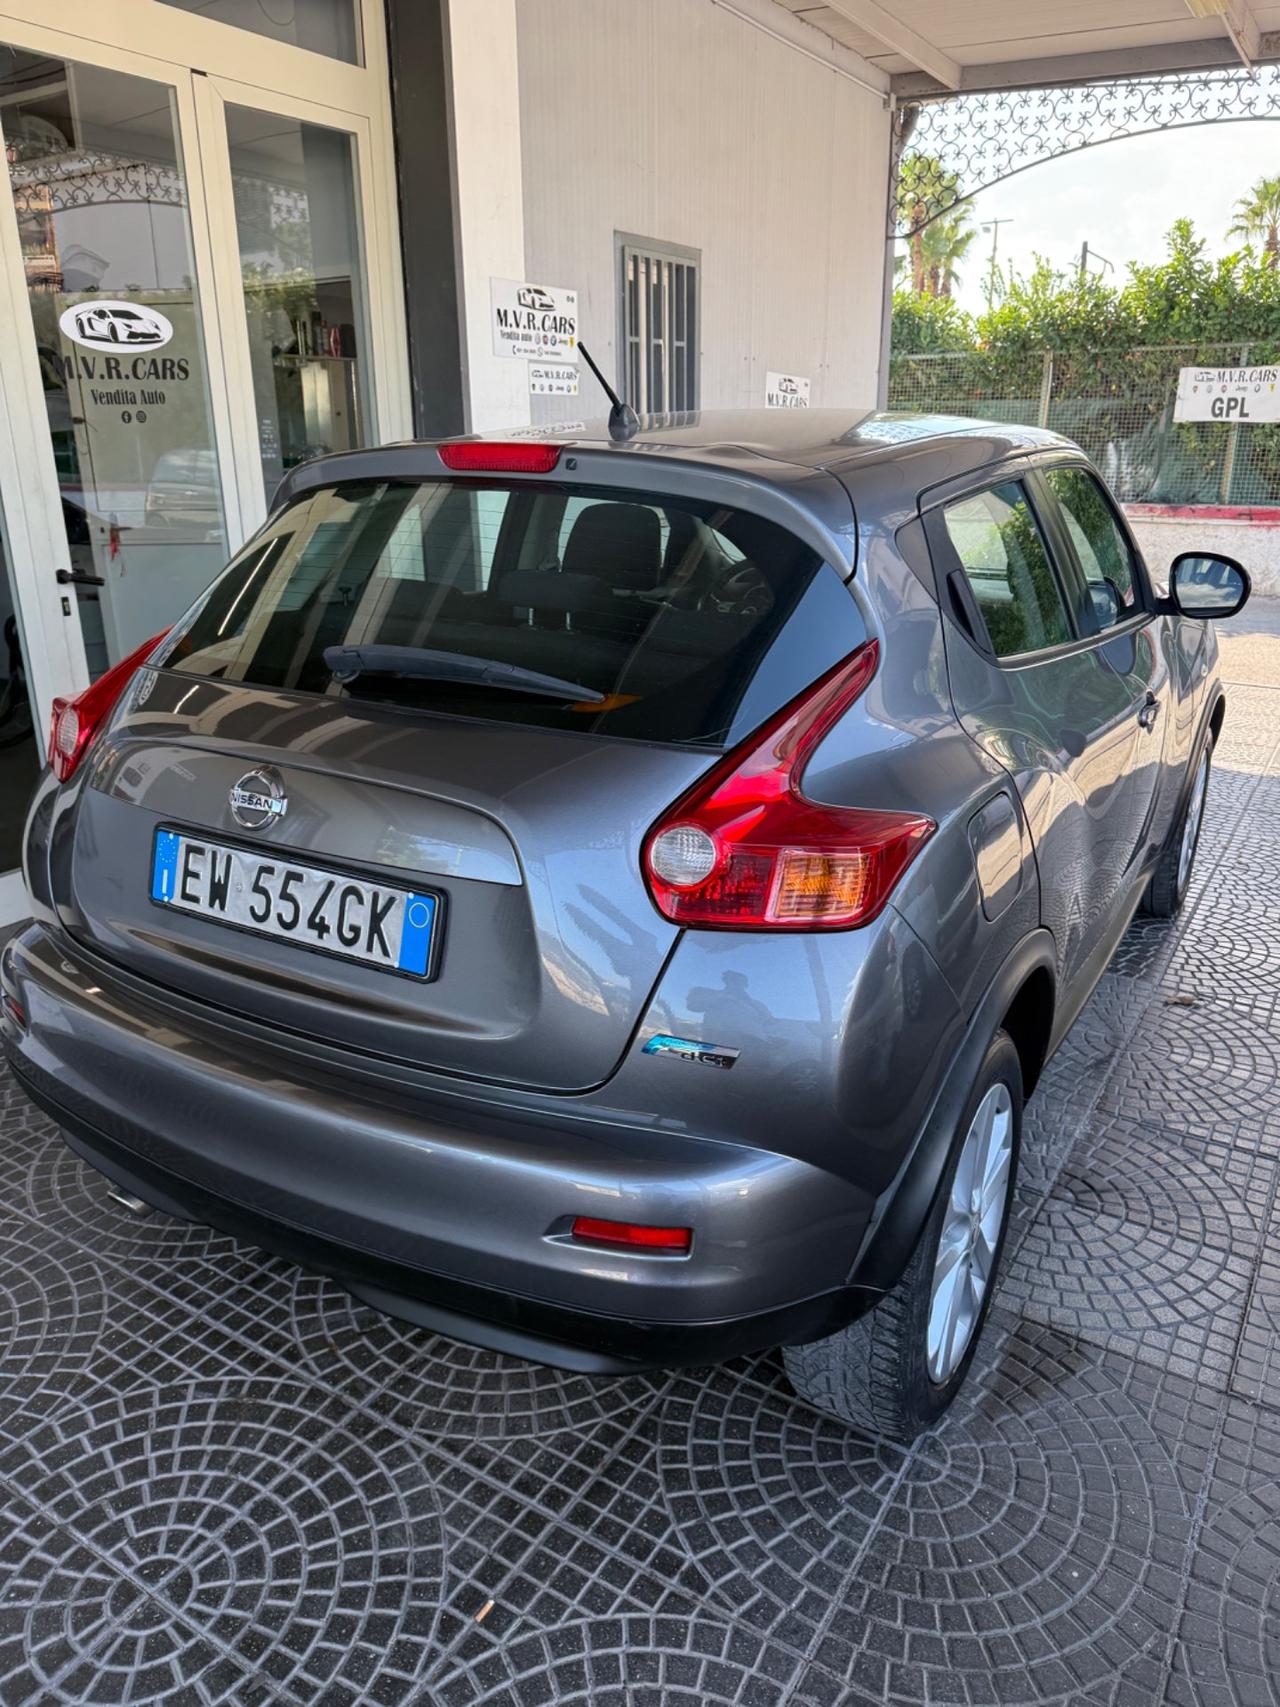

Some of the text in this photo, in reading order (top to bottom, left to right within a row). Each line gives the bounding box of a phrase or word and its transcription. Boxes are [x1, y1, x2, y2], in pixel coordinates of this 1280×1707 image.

[496, 308, 576, 335] M.V.R.CARS
[1217, 369, 1278, 383] M.V.R.CARS
[91, 389, 166, 405] Vendita Auto
[1211, 397, 1249, 418] GPL
[231, 791, 273, 809] NISSAN
[180, 843, 398, 958] EW 554GK
